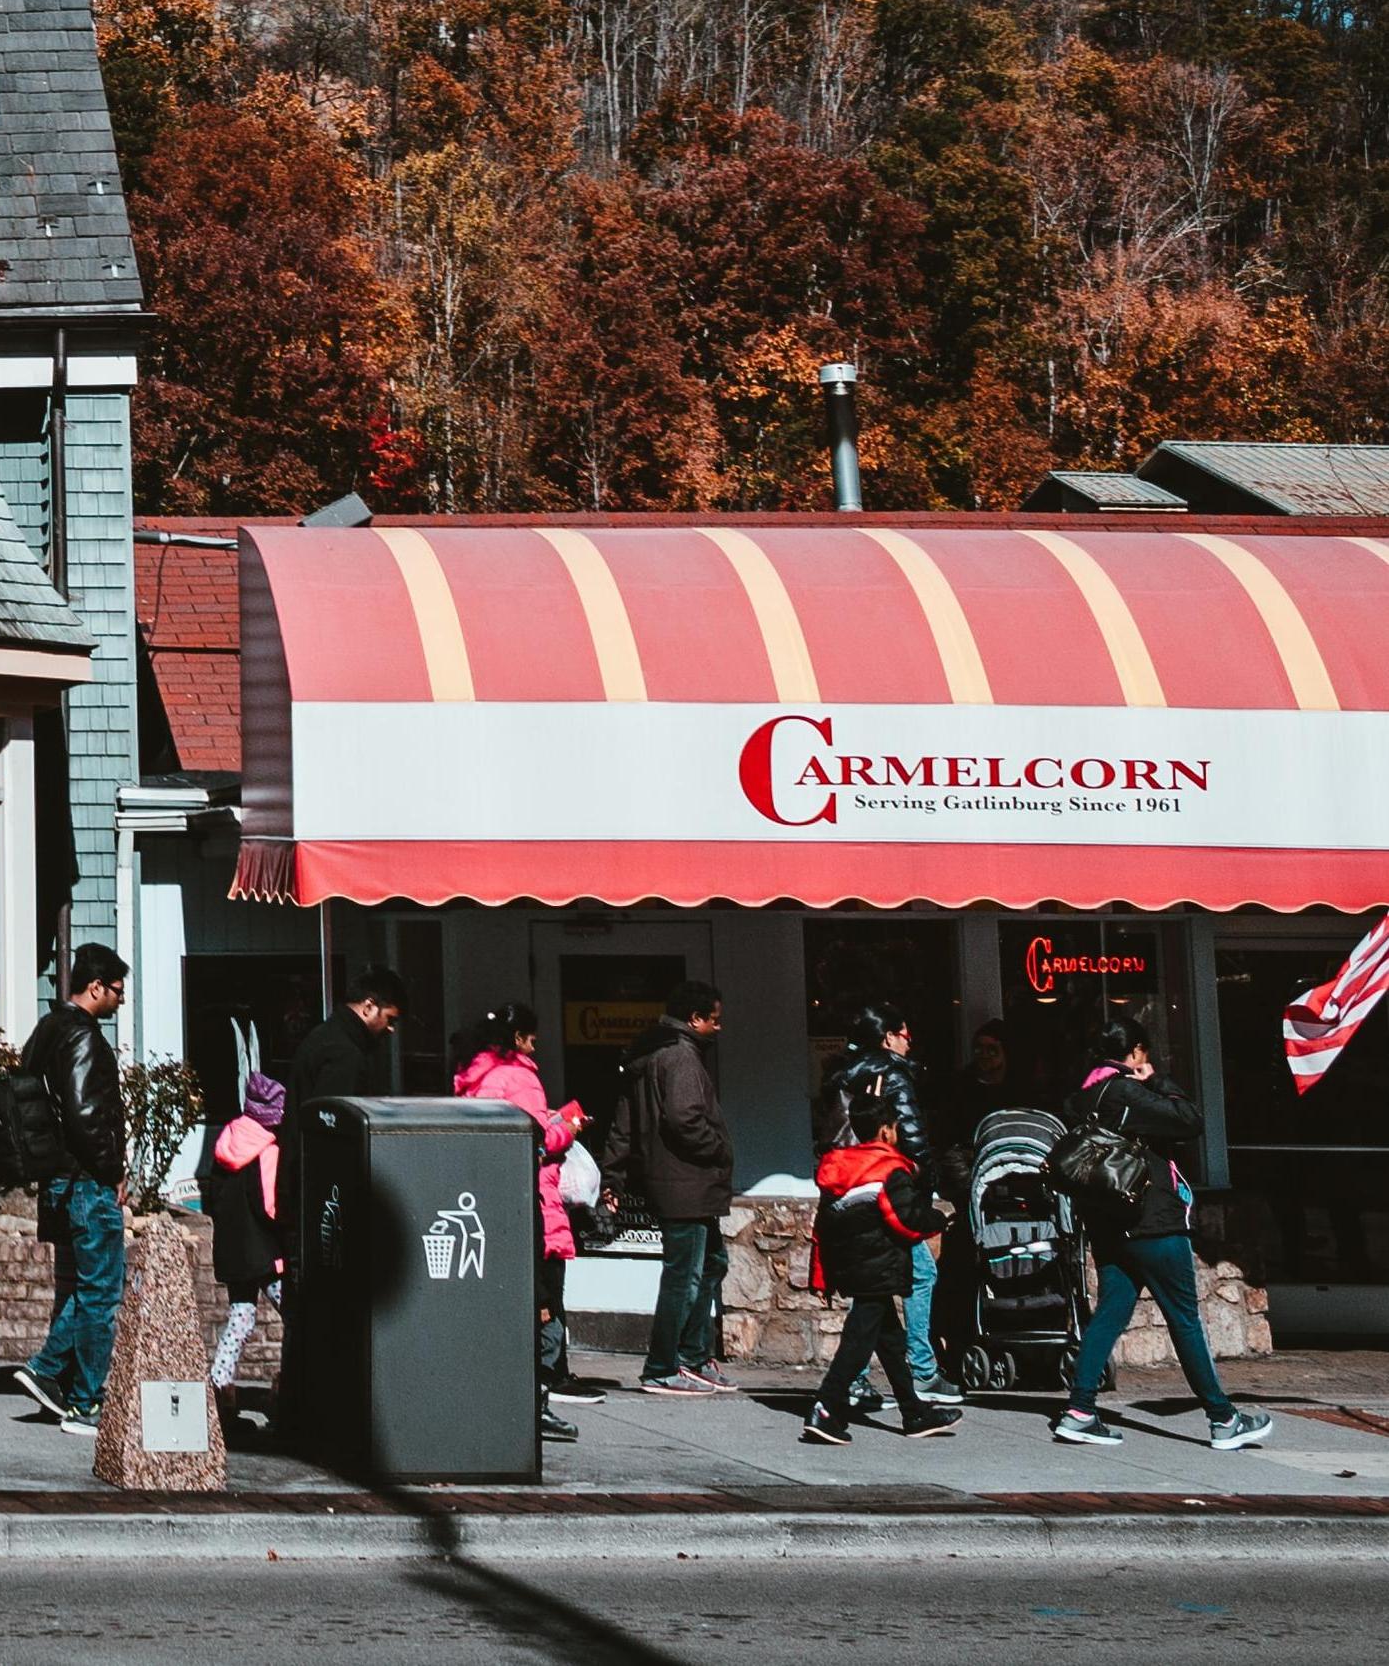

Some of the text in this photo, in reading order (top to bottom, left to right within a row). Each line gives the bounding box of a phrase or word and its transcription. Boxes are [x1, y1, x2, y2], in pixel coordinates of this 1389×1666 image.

[738, 715, 1212, 826] CARMELCORN
[854, 794, 1182, 816] Serving Gatlinburg Since 1961
[1026, 937, 1145, 993] CARMELCORN
